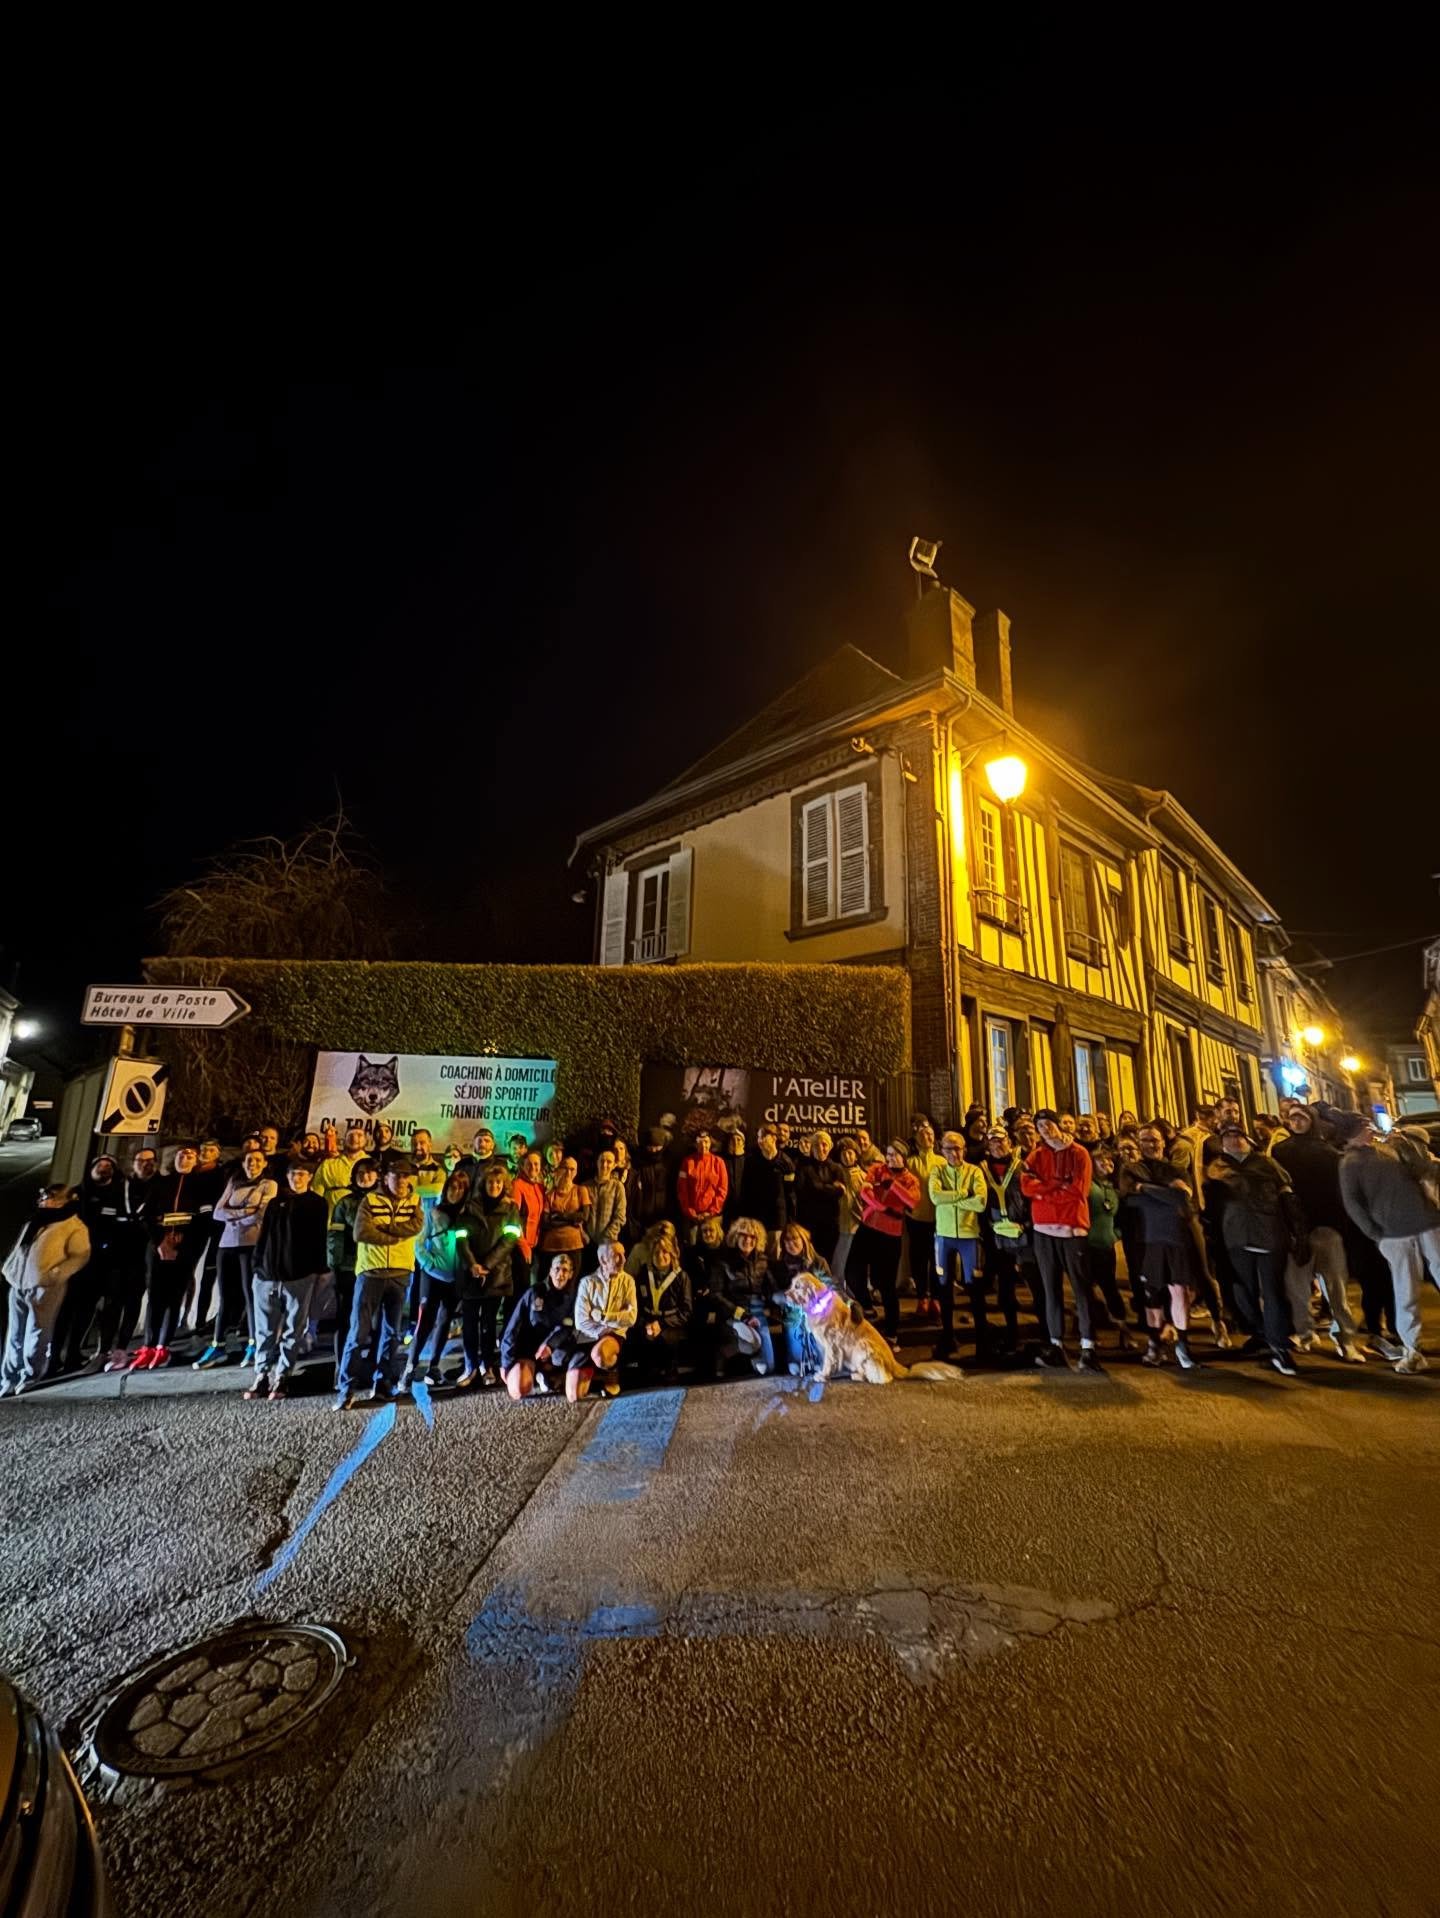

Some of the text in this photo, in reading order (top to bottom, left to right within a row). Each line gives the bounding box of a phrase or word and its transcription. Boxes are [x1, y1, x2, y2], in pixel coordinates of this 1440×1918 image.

[94, 992, 217, 1006] Bureau de Poste
[90, 1006, 196, 1019] Hôtel de Ville
[440, 1065, 493, 1080] COACHING
[495, 1064, 502, 1081] À
[454, 1083, 540, 1102] SÉJOUR SPORTIF
[440, 1104, 550, 1121] TRAINING EXTÉRIEUR
